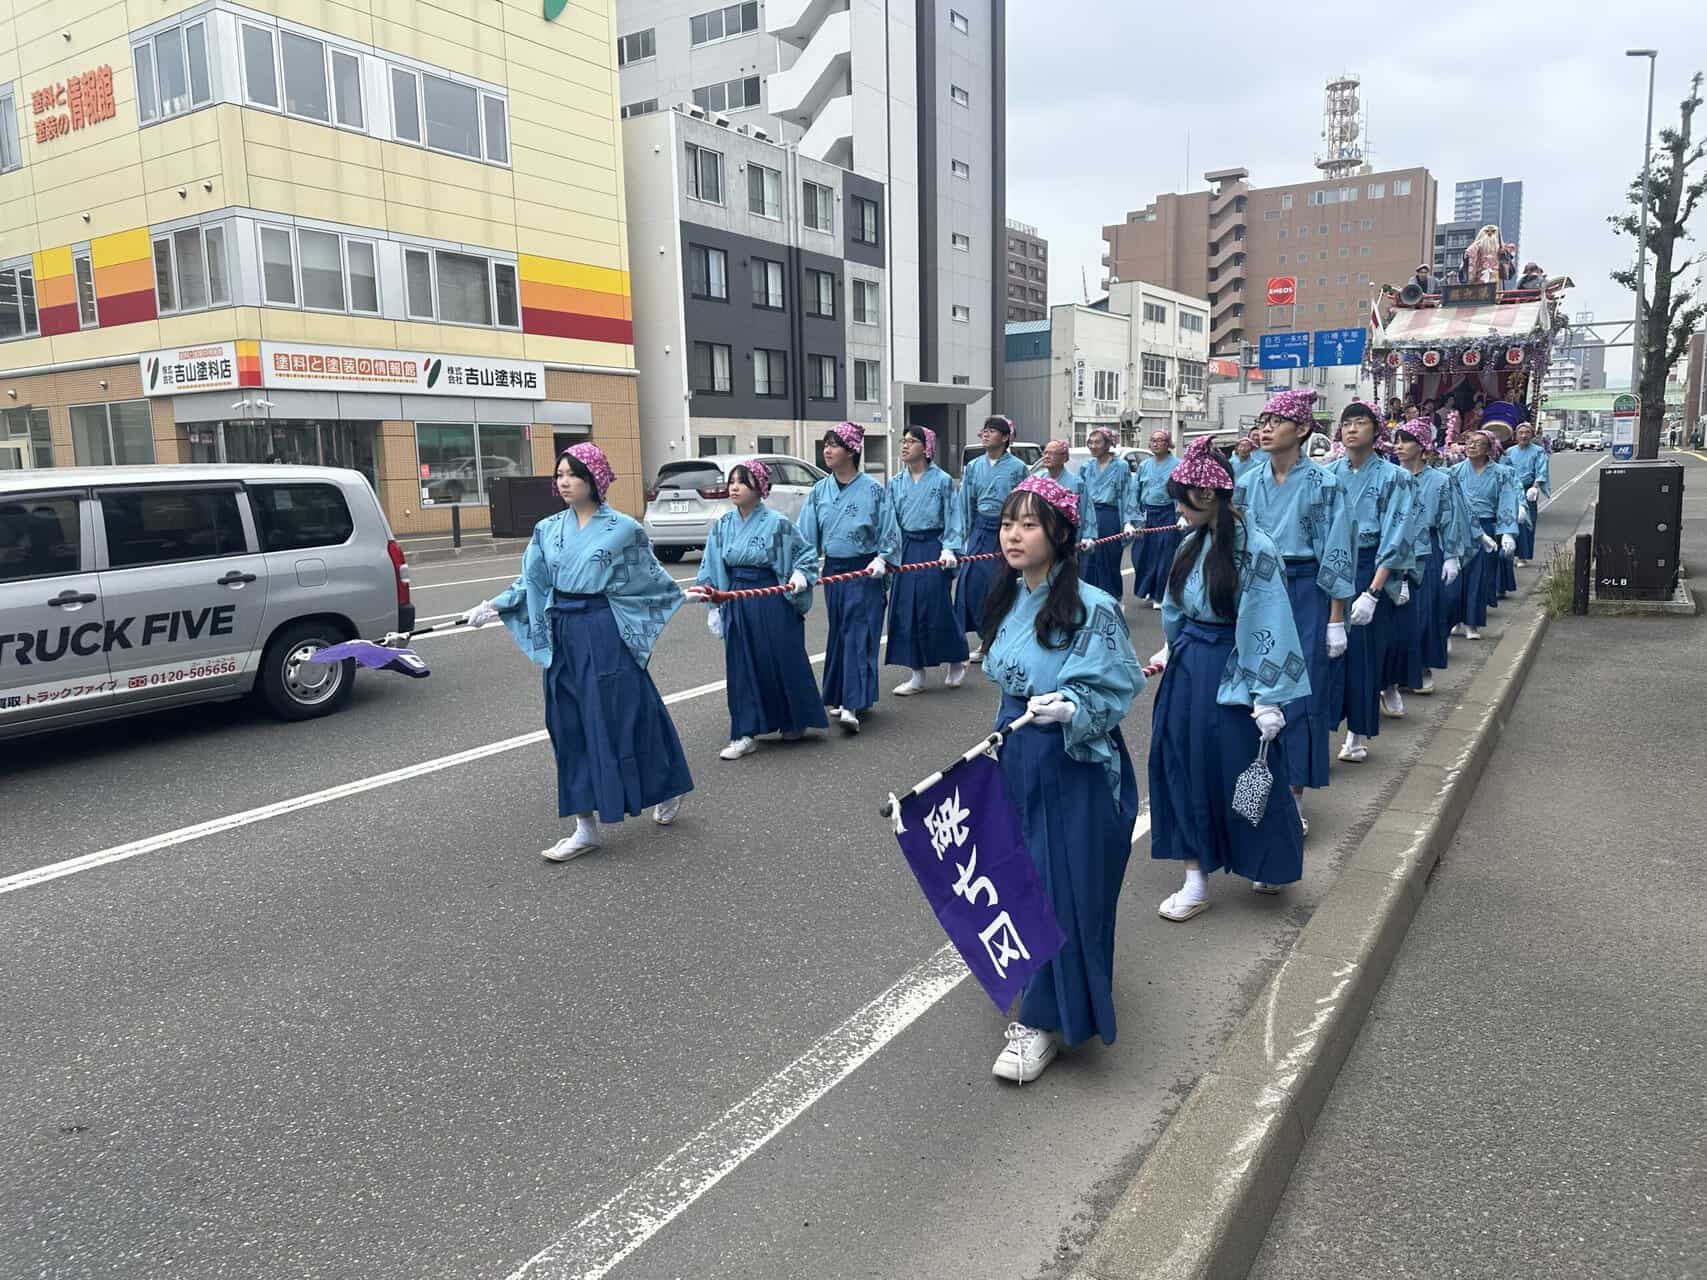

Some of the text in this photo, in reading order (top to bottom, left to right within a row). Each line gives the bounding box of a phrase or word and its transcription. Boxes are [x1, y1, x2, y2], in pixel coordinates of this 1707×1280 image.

[31, 81, 67, 115] 塗料と
[66, 63, 116, 132] 情報館
[34, 113, 70, 144] 塗装の
[174, 358, 232, 383] 吉山塗料店
[274, 353, 418, 378] 塗料と塗装の情報館
[465, 367, 537, 389] 吉山塗料店
[0, 604, 236, 666] TRUCK FIVE
[150, 662, 236, 685] 0120-505656
